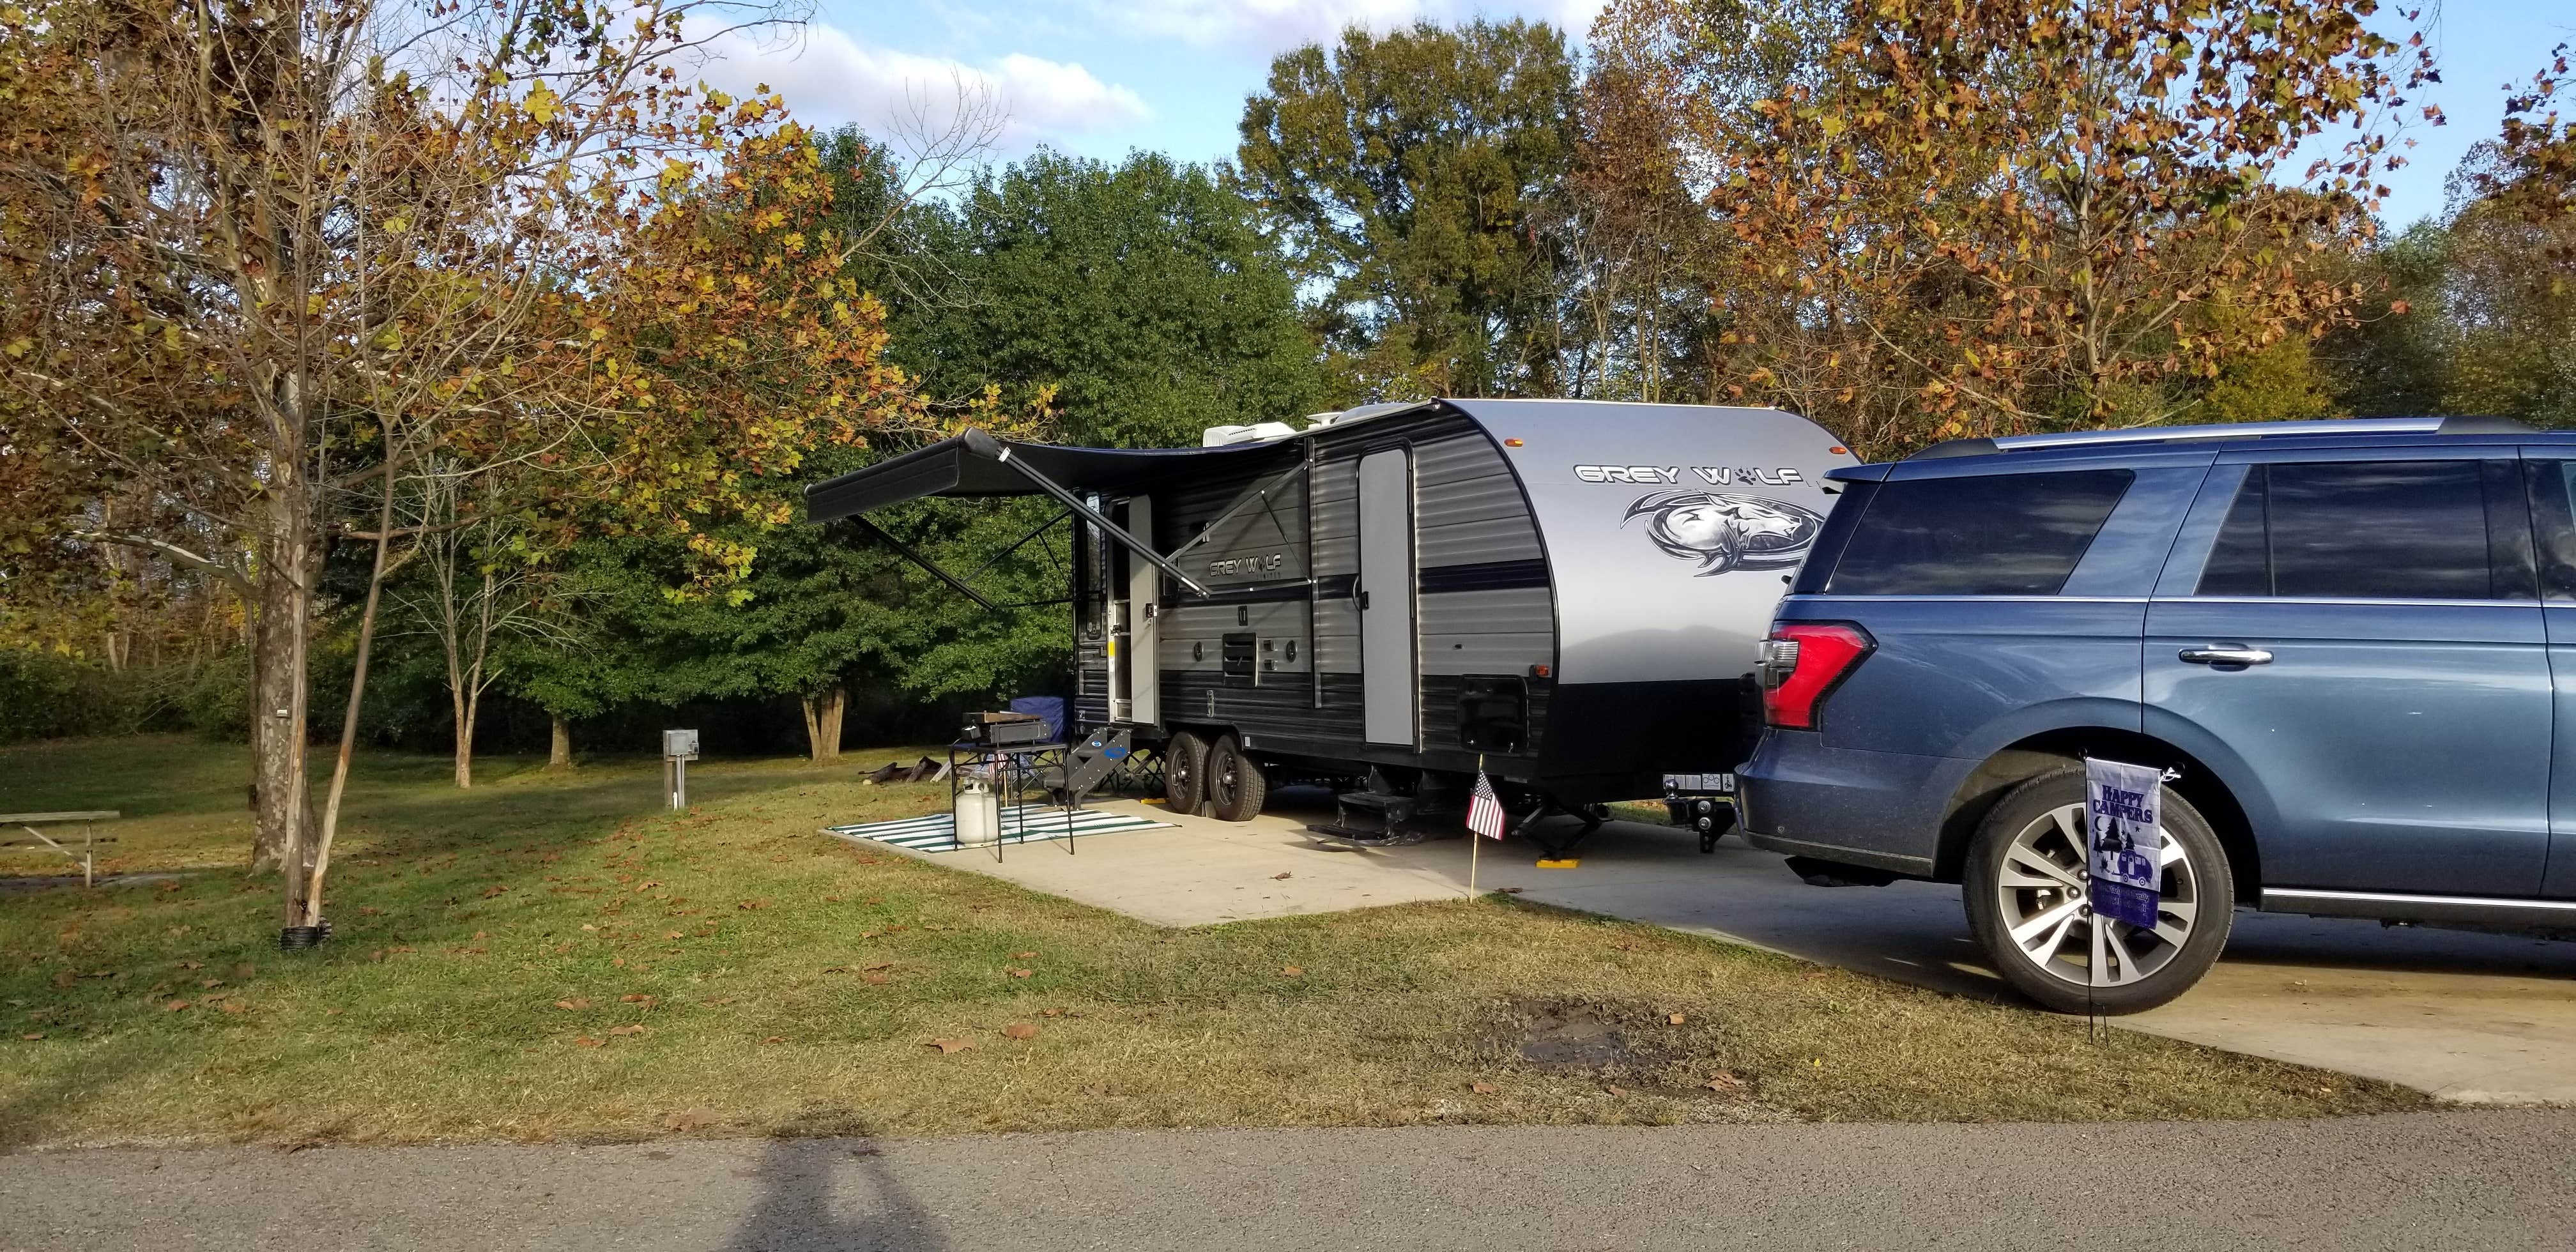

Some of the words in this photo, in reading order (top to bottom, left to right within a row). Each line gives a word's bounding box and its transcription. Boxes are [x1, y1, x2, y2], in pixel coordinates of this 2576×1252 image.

[1573, 464, 1680, 485] GREY
[1690, 466, 1805, 486] WLF
[1209, 558, 1242, 576] GREY
[1246, 553, 1281, 573] WLF
[2102, 784, 2145, 808] HAPPY
[2092, 799, 2154, 824] CAMPERS
